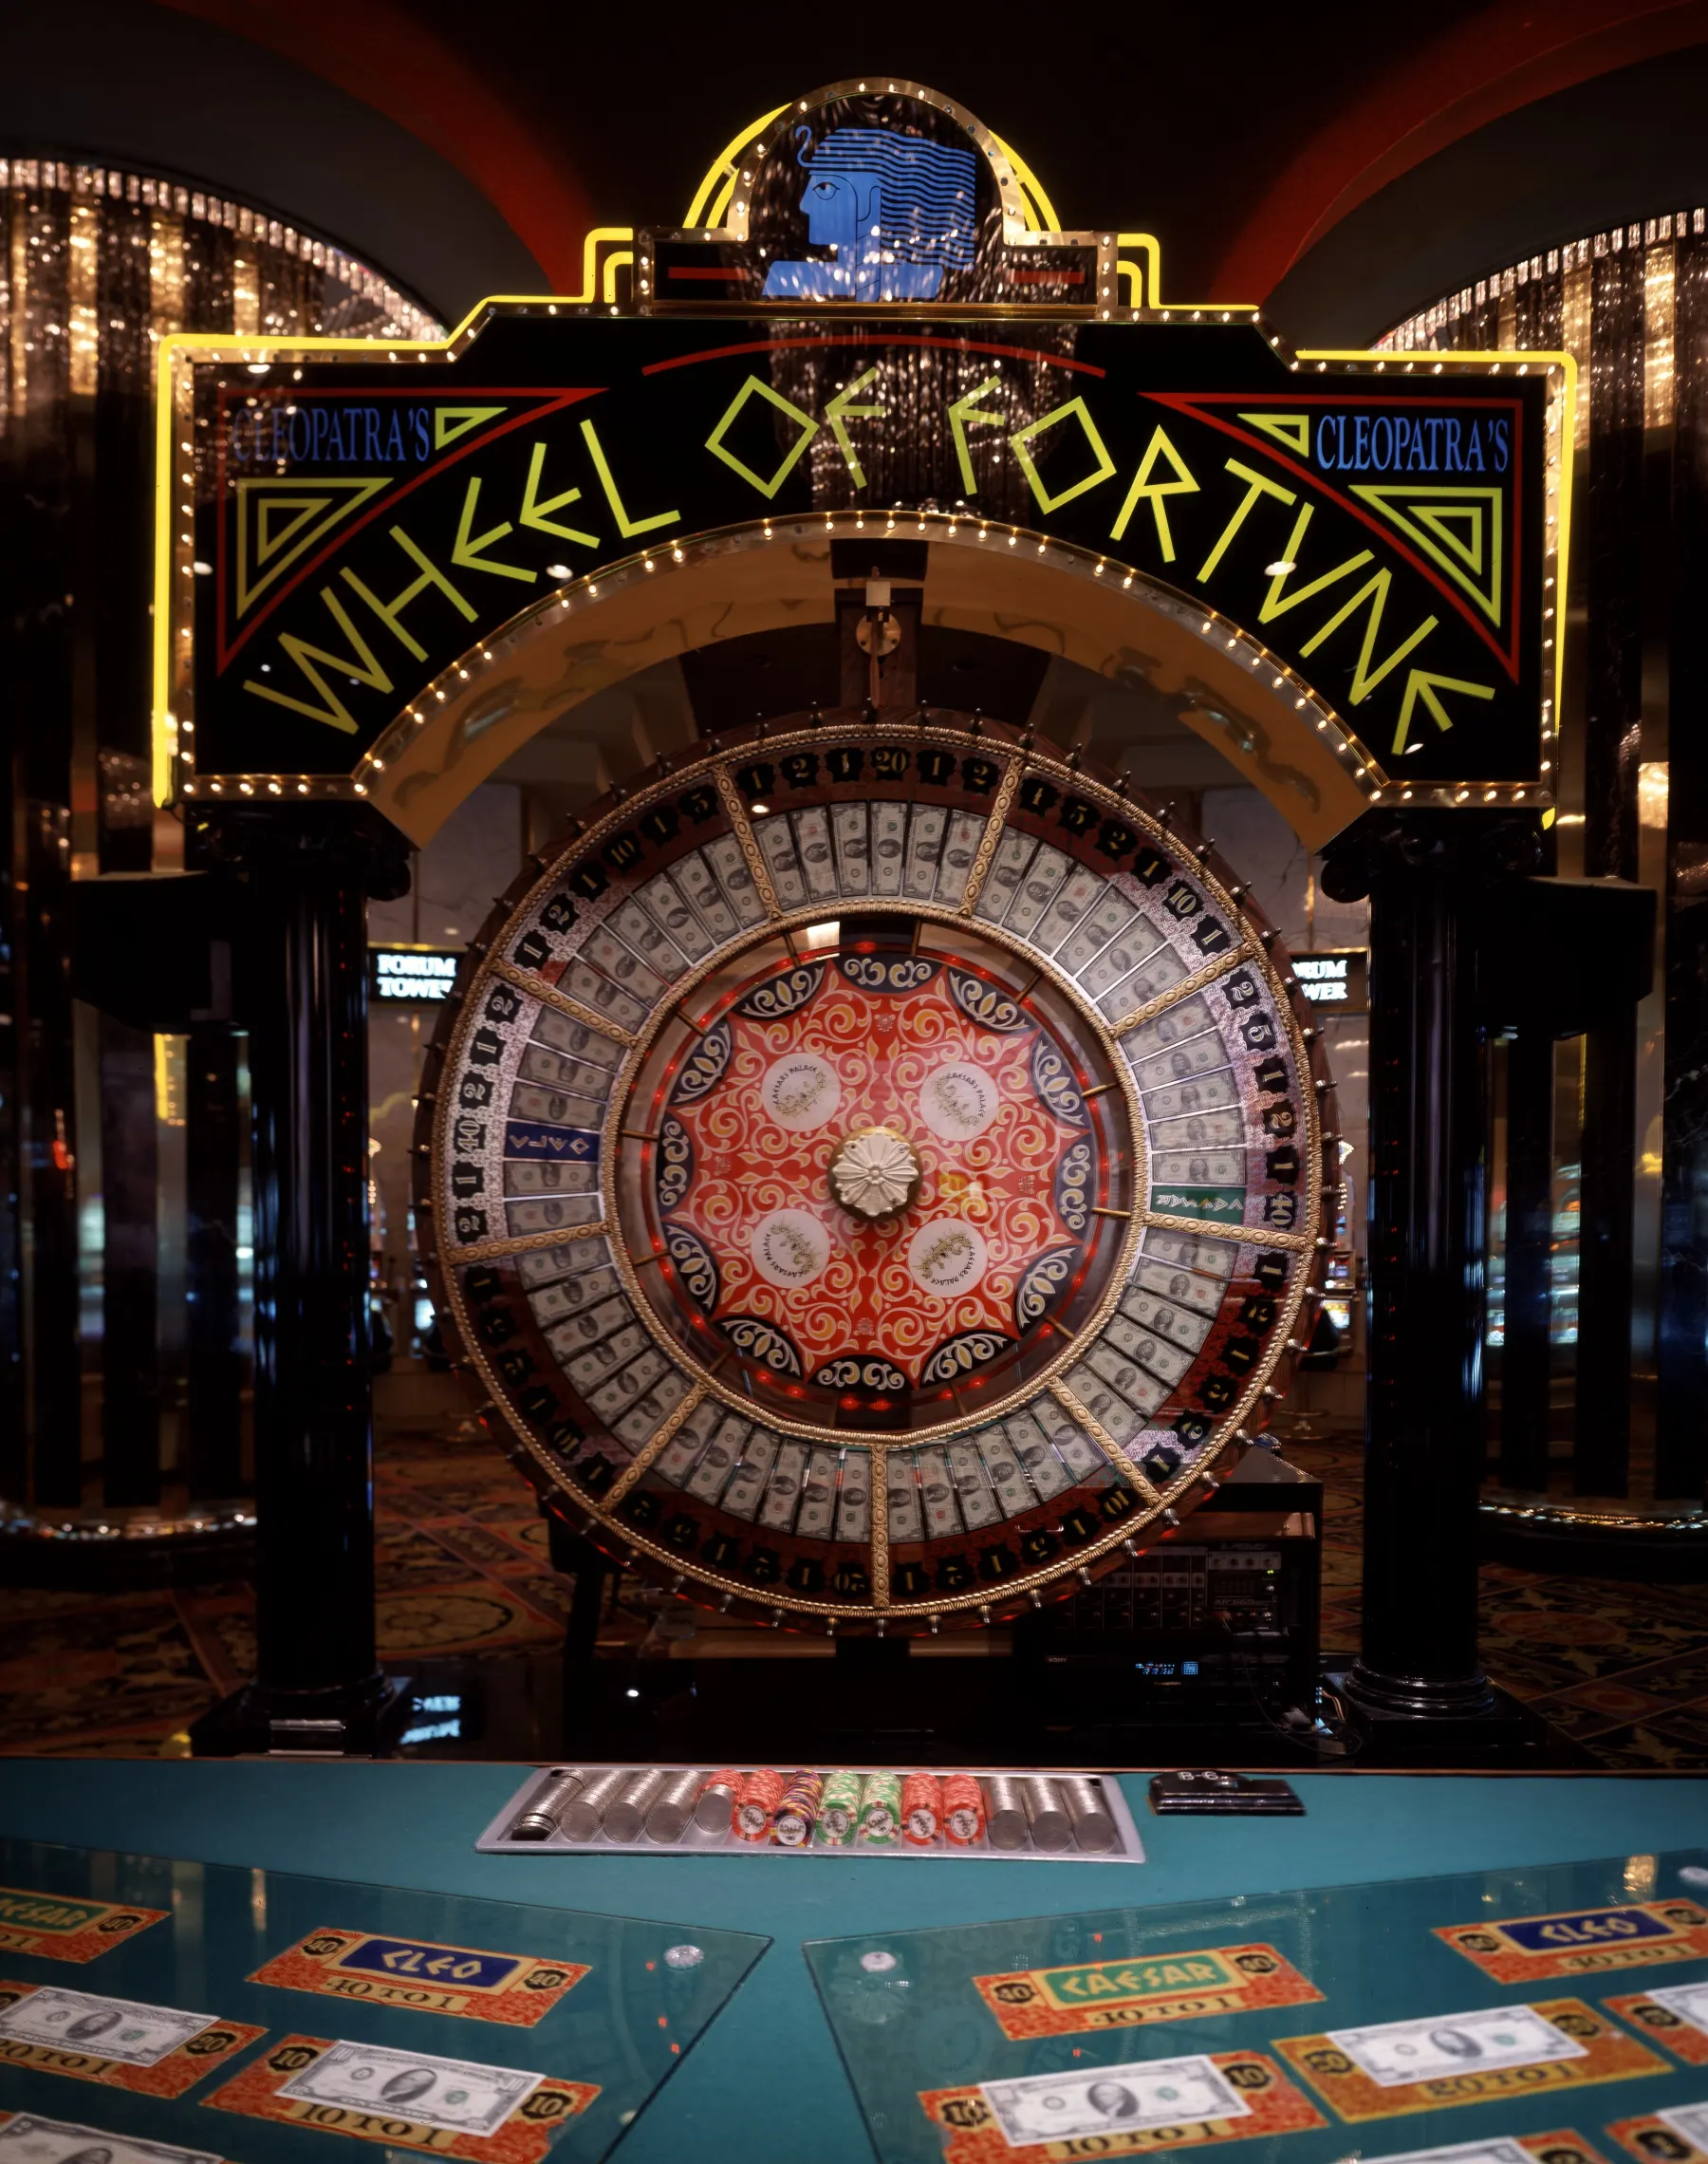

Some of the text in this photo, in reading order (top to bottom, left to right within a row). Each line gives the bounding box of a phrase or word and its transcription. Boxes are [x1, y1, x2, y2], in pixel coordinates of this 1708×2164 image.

[233, 407, 431, 461] CLEOPATRA'S
[1316, 414, 1509, 473] CLEOPATRA'S
[243, 419, 681, 735] WHEEL
[704, 366, 886, 500] OF
[790, 760, 808, 778] 2
[841, 752, 850, 774] 1
[874, 750, 908, 774] 20
[931, 756, 941, 776] 1
[752, 769, 763, 791] 1
[973, 762, 990, 786] 2
[1031, 786, 1044, 806] 1
[653, 814, 668, 834] 1
[1069, 805, 1088, 825] 5
[610, 839, 636, 865] 10
[1142, 860, 1160, 879] 1
[580, 872, 599, 890] 1
[1166, 886, 1197, 914] 10
[547, 904, 569, 926] 2
[1200, 928, 1223, 946] 1
[522, 942, 544, 961] 1
[377, 954, 456, 978] FORUM
[1230, 980, 1254, 1001] 2
[491, 996, 514, 1017] 2
[1247, 1022, 1273, 1044] 5
[476, 1039, 498, 1054] 1
[945, 1072, 979, 1089] CAESARS
[1262, 1069, 1286, 1083] 1
[463, 1082, 486, 1100] 2
[1269, 1111, 1293, 1130] 2
[457, 1120, 481, 1153] 40
[1272, 1161, 1295, 1172] 1
[455, 1175, 477, 1186] 1
[1156, 1193, 1244, 1213] CAESAR
[1271, 1193, 1293, 1226] 40
[458, 1214, 481, 1233] 2
[1261, 1264, 1283, 1276] 1
[1230, 1349, 1251, 1362] 1
[1179, 1422, 1203, 1441] 2
[1152, 1454, 1171, 1472] 1
[1104, 1489, 1130, 1516] 10
[1072, 1519, 1086, 1537] 1
[715, 1542, 728, 1562] 1
[991, 1555, 1002, 1574] 1
[801, 1565, 811, 1587] 1
[904, 1571, 914, 1592] 1
[1540, 1917, 1640, 1942] CLEO
[307, 1938, 341, 1956] 40
[381, 1949, 482, 1980] CLEO
[527, 1969, 562, 1989] 40
[1061, 1961, 1220, 1997] CAESAR
[325, 1978, 374, 1997] 40
[378, 1985, 430, 2005] TO
[1092, 2009, 1144, 2025] 40
[1146, 2000, 1208, 2019] TO
[189, 2035, 228, 2051] 20
[36, 2050, 90, 2068] TO
[273, 2050, 311, 2068] 10
[1231, 2067, 1266, 2087] 10
[1485, 2065, 1548, 2086] TO
[529, 2095, 566, 2115] 10
[950, 2104, 981, 2123] 10
[302, 2104, 347, 2125] 10
[352, 2116, 414, 2137] TO
[1062, 2136, 1111, 2155] 10
[1114, 2124, 1184, 2145] TO
